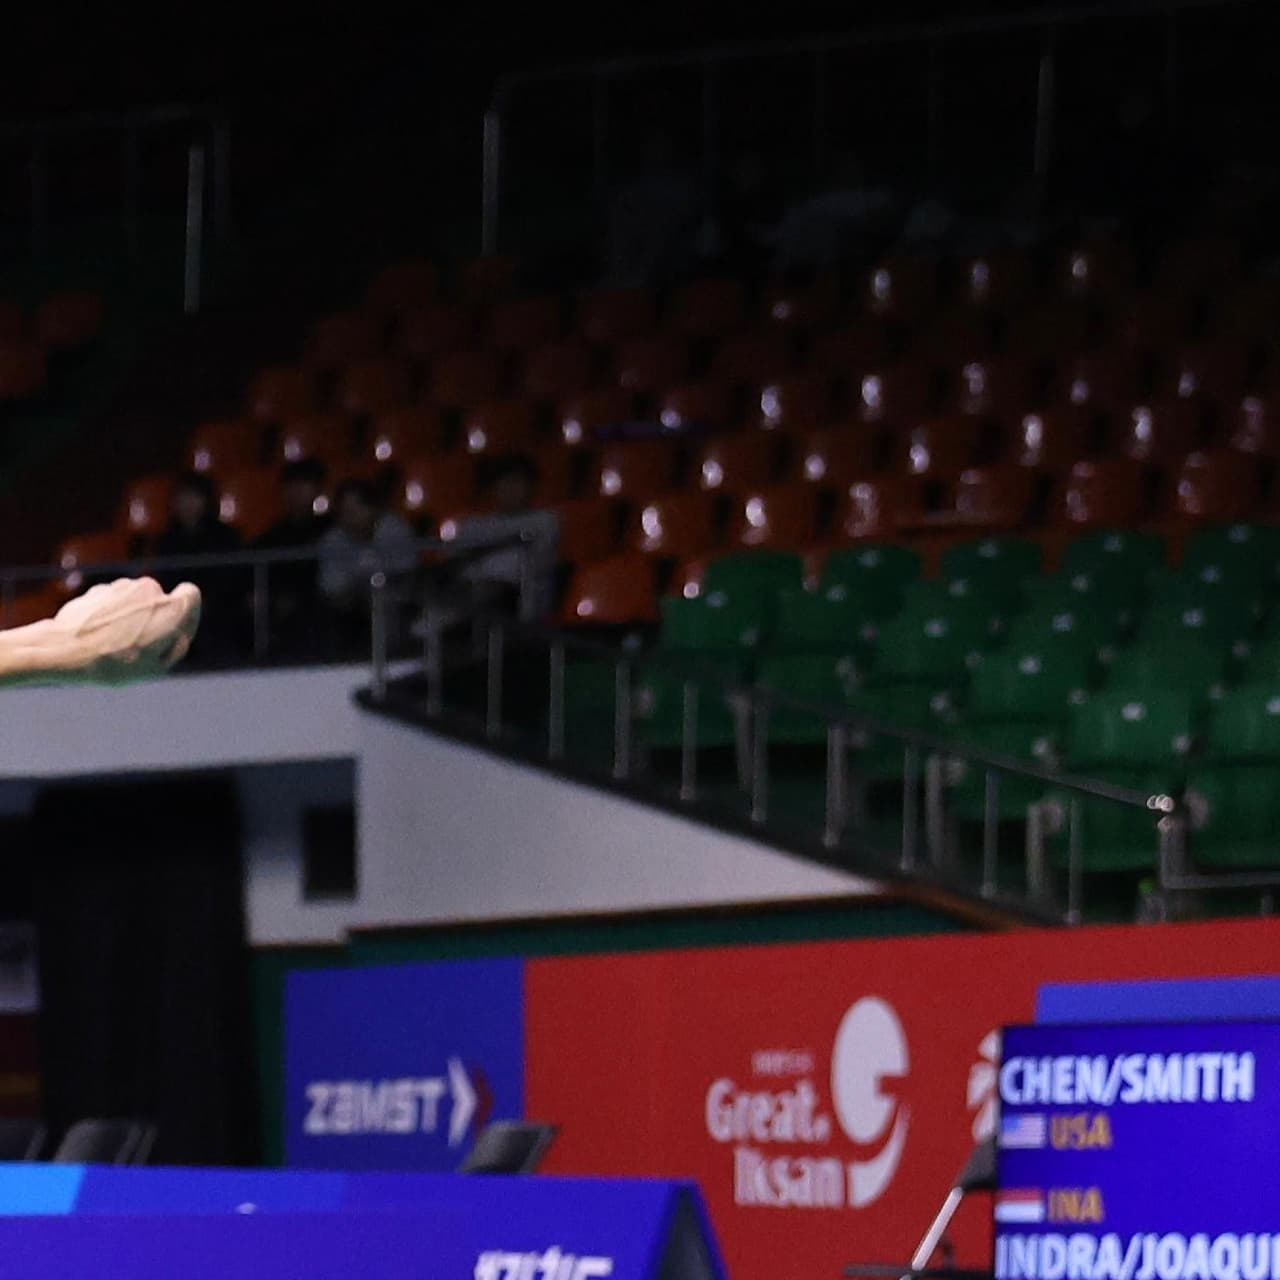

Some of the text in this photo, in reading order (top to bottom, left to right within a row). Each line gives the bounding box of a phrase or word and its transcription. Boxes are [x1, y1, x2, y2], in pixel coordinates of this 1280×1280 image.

[998, 1051, 1256, 1106] CHEN/SMITH
[1049, 1113, 1112, 1150] USA
[1046, 1186, 1104, 1223] INA
